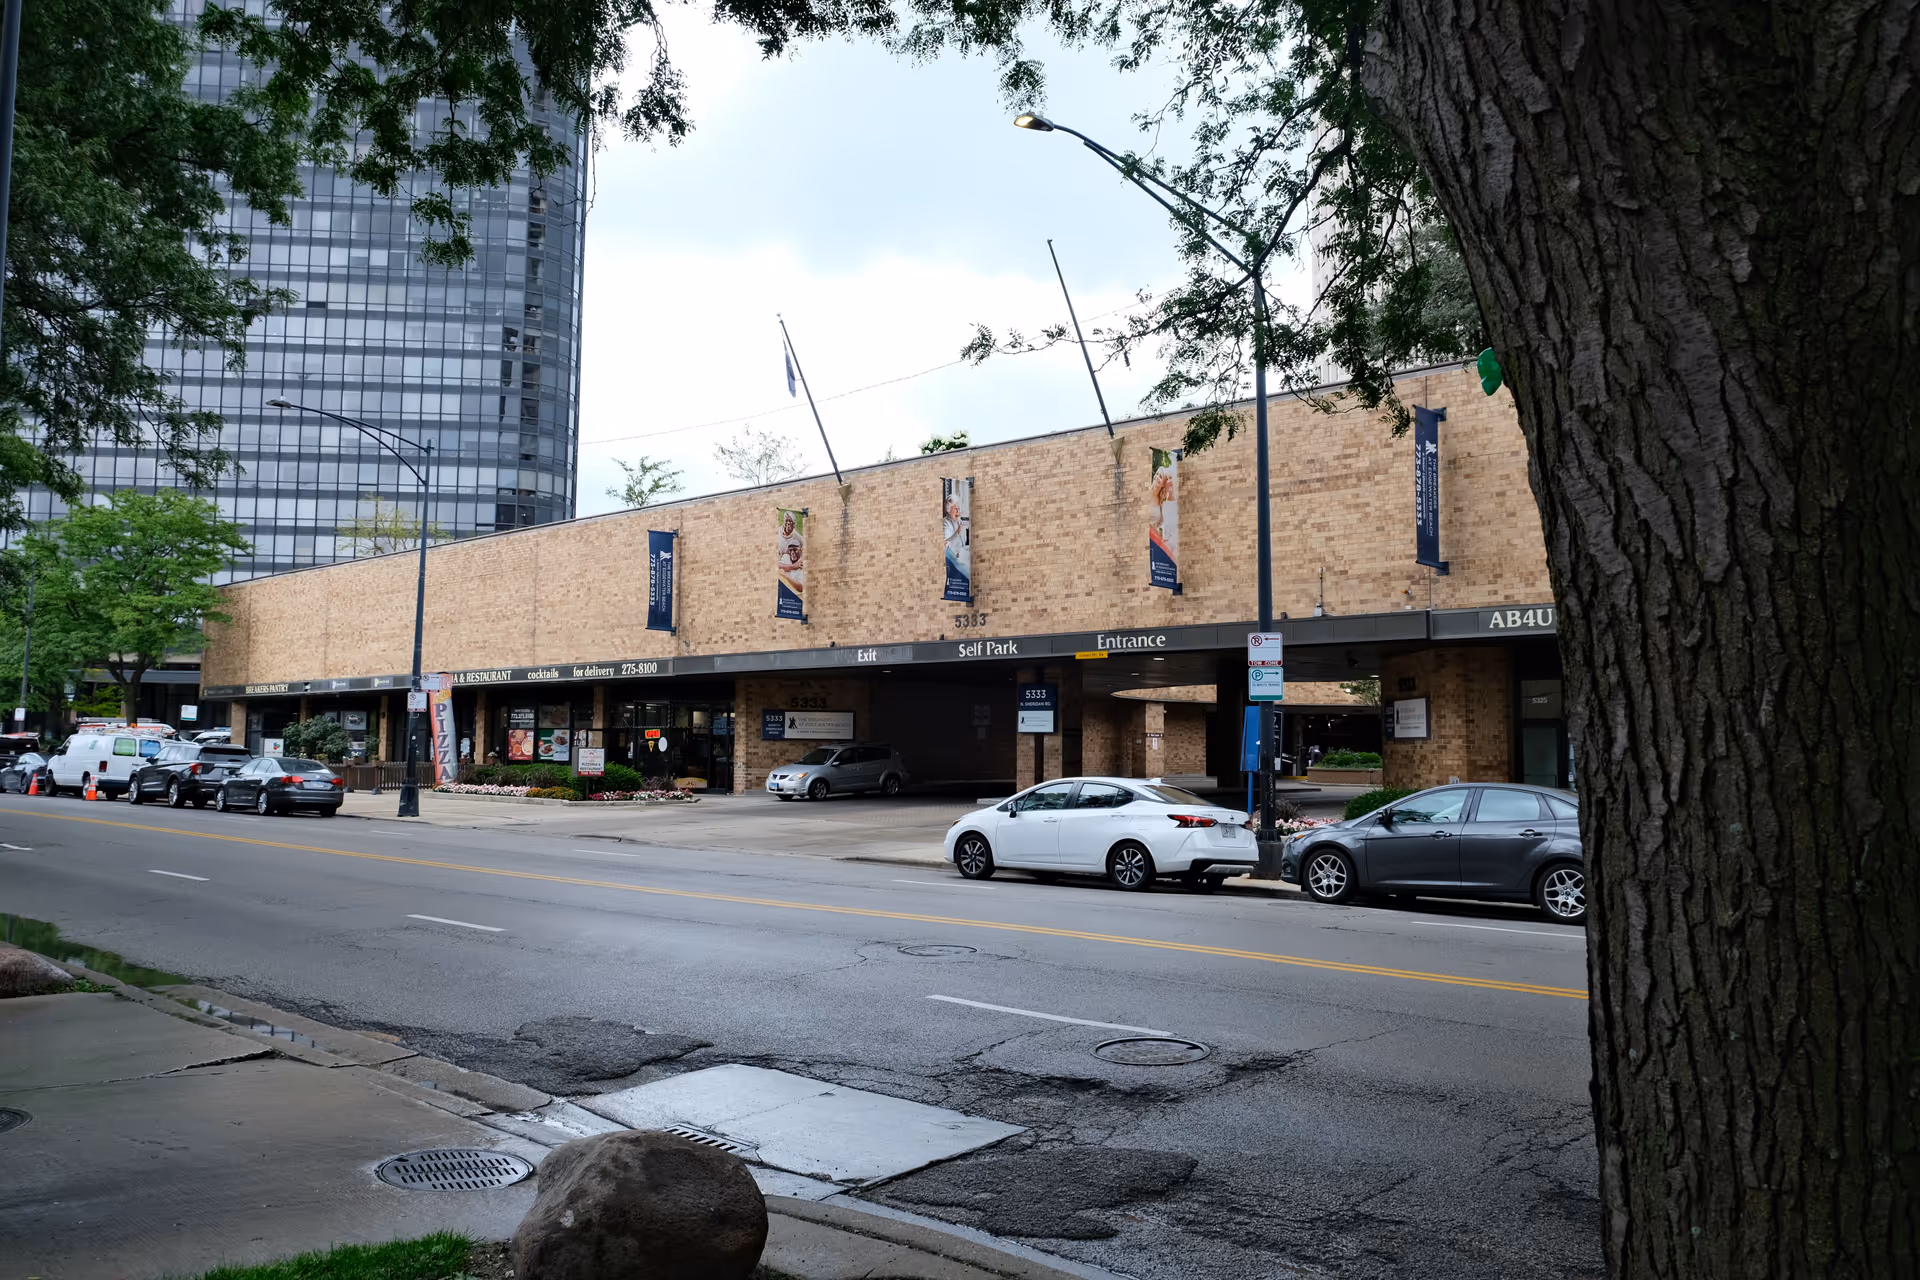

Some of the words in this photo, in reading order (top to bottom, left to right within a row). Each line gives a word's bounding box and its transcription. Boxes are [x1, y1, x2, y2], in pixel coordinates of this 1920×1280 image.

[1489, 608, 1553, 629] AB4U
[958, 641, 984, 657] Self
[986, 640, 1018, 656] Park
[1097, 633, 1167, 650] Entrance
[857, 648, 877, 662] Exit
[459, 673, 466, 683] &
[466, 670, 512, 683] RESTAURANT
[527, 668, 559, 680] cocktails
[573, 666, 584, 678] for
[584, 665, 615, 677] delivery
[621, 662, 658, 675] 275-8100
[245, 684, 269, 694] BREAKERS
[269, 683, 289, 693] PANTRY
[1025, 689, 1047, 699] 5333
[434, 703, 453, 780] PIZZA
